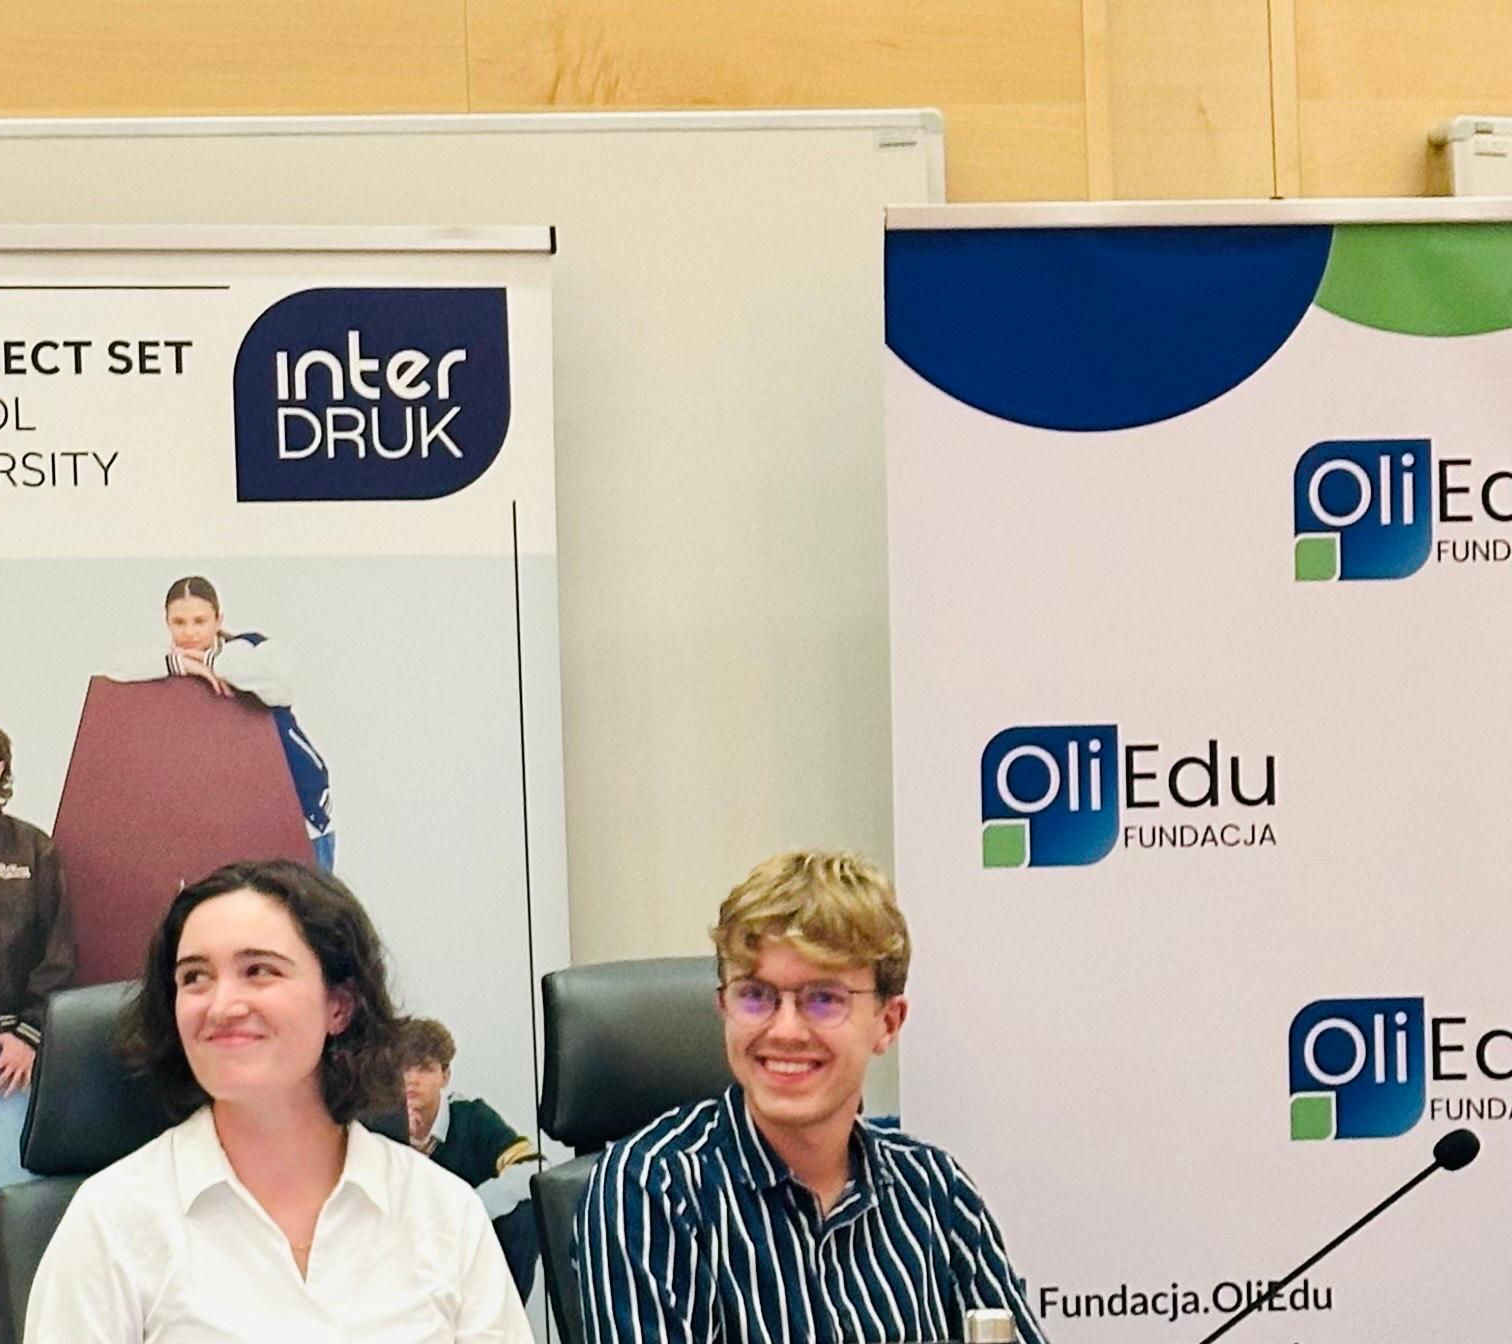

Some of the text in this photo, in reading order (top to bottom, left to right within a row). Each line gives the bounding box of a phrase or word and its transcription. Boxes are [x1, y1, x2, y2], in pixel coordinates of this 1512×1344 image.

[108, 341, 193, 375] SET
[276, 330, 466, 400] inter
[278, 406, 463, 459] DRUK
[996, 738, 1275, 813] OliEdu
[1124, 823, 1277, 848] FUNDACJA
